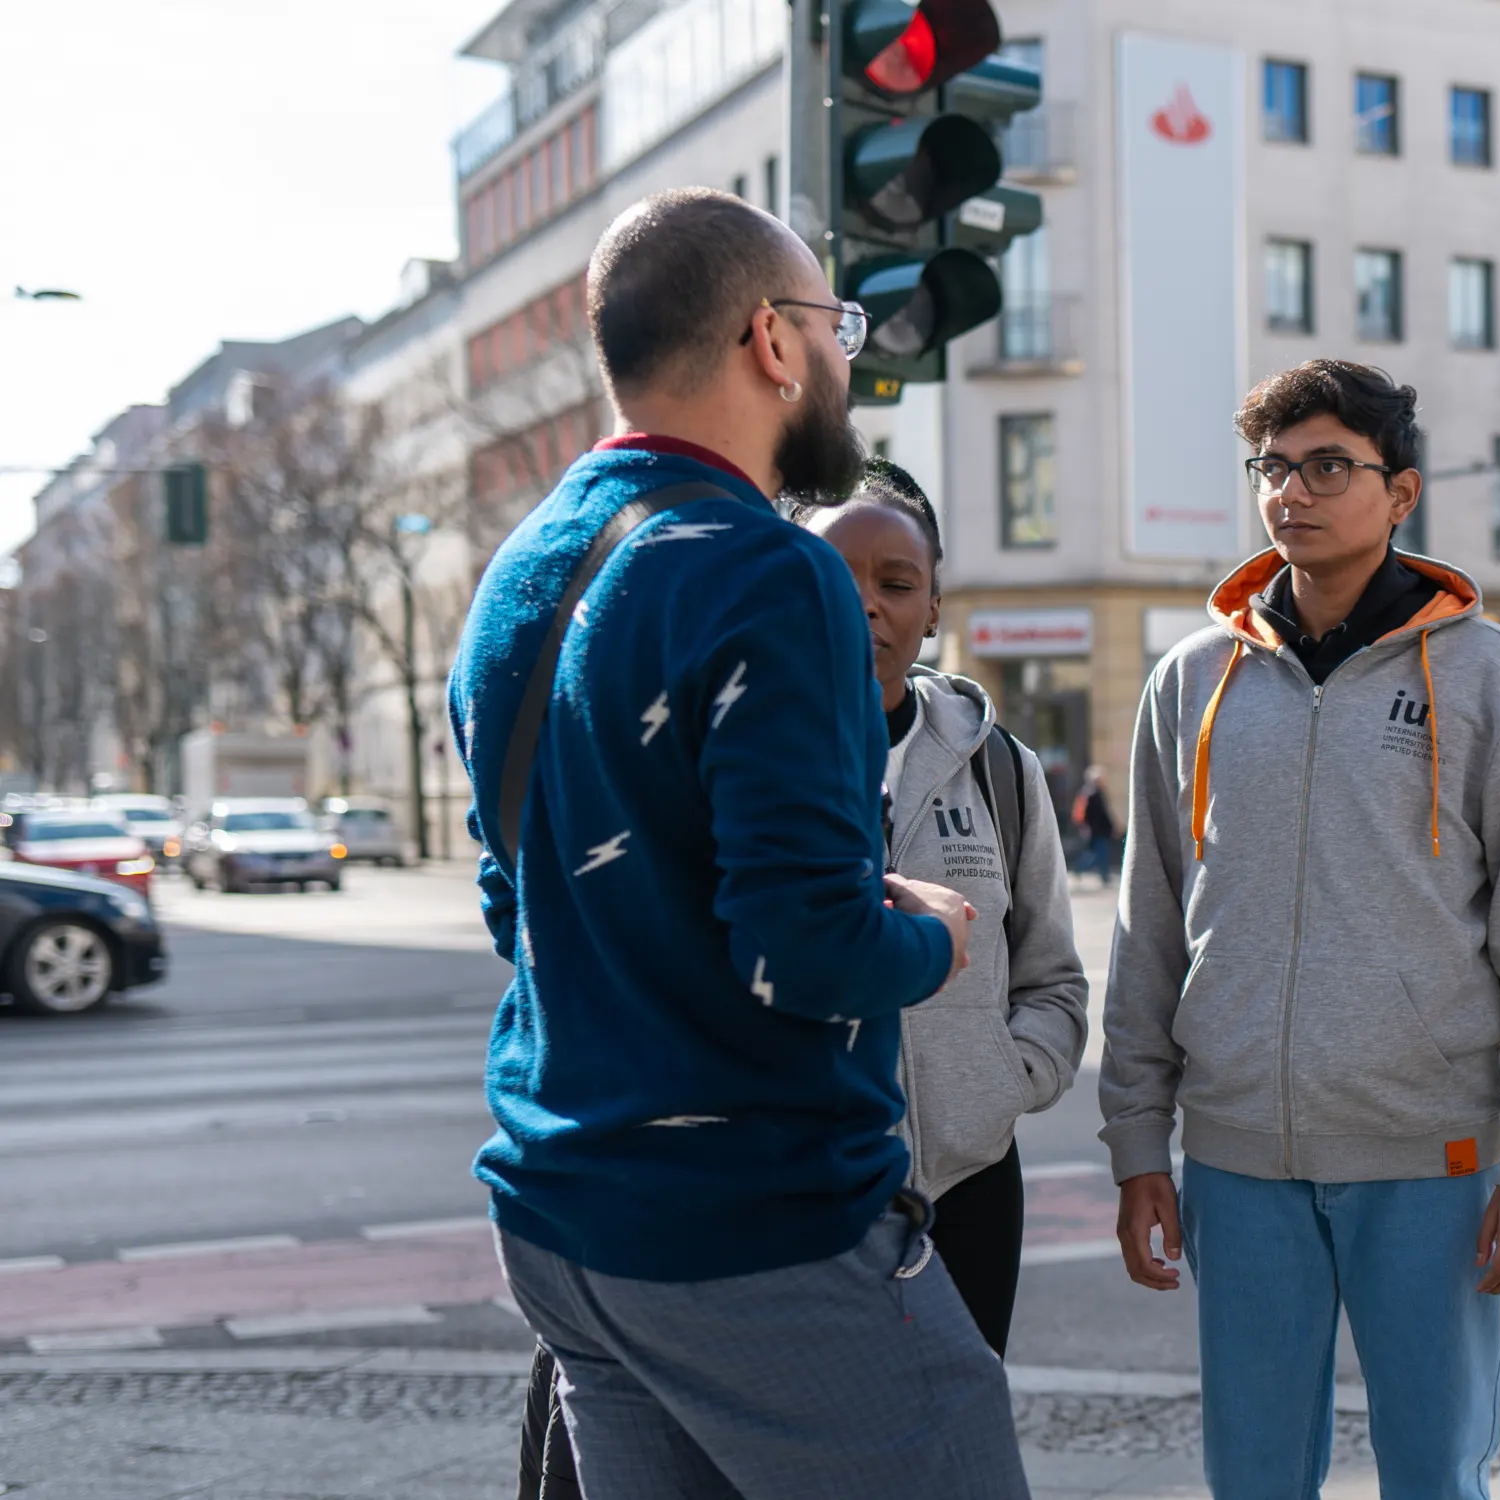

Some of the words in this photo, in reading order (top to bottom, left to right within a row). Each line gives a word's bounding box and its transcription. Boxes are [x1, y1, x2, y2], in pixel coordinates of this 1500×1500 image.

[1388, 690, 1430, 727] iu
[1382, 734, 1426, 750] UNIVERSITY
[1380, 743, 1411, 756] APPLIED
[1412, 749, 1446, 765] SCIENES
[932, 797, 977, 837] iu
[942, 843, 996, 856] INTERNATIONAL
[943, 855, 986, 866] UNIVERSITY
[986, 856, 994, 867] OF
[945, 868, 978, 878] APPLIED
